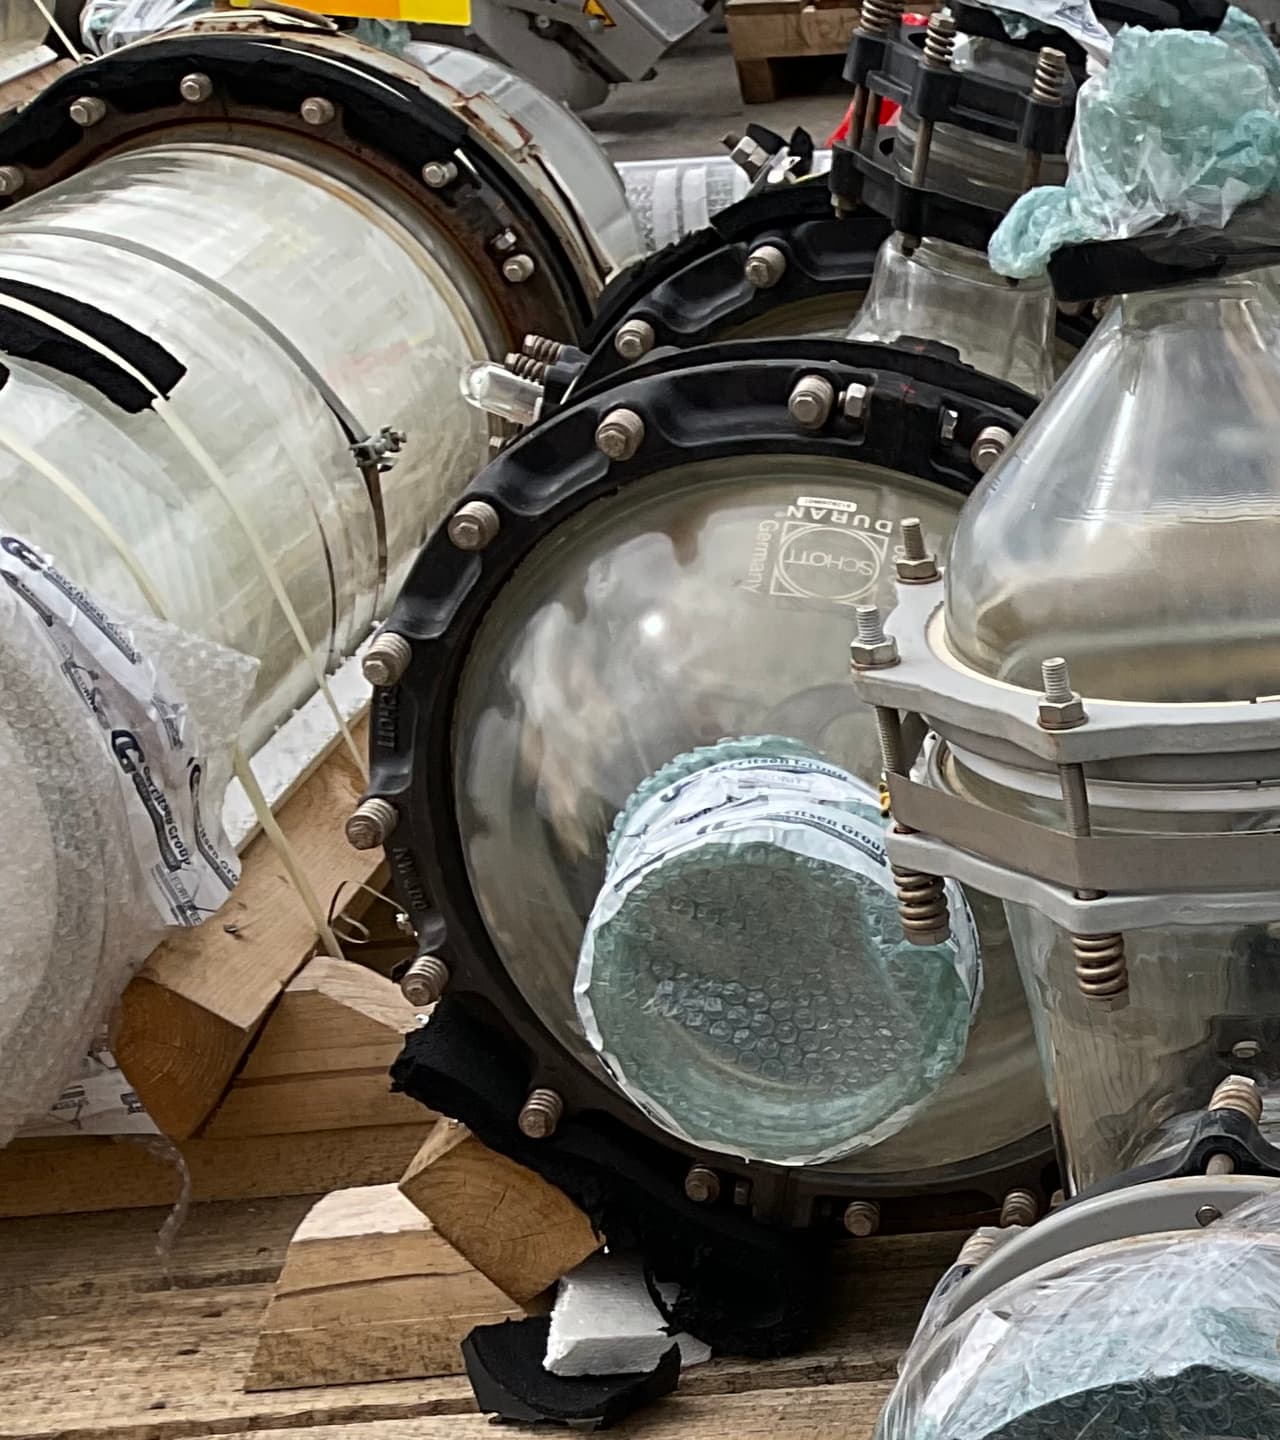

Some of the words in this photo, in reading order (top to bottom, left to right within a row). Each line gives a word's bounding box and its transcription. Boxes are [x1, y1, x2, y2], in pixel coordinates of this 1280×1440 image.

[786, 505, 894, 533] DURAN
[741, 519, 780, 594] Germany
[784, 548, 875, 577] SCHOTT
